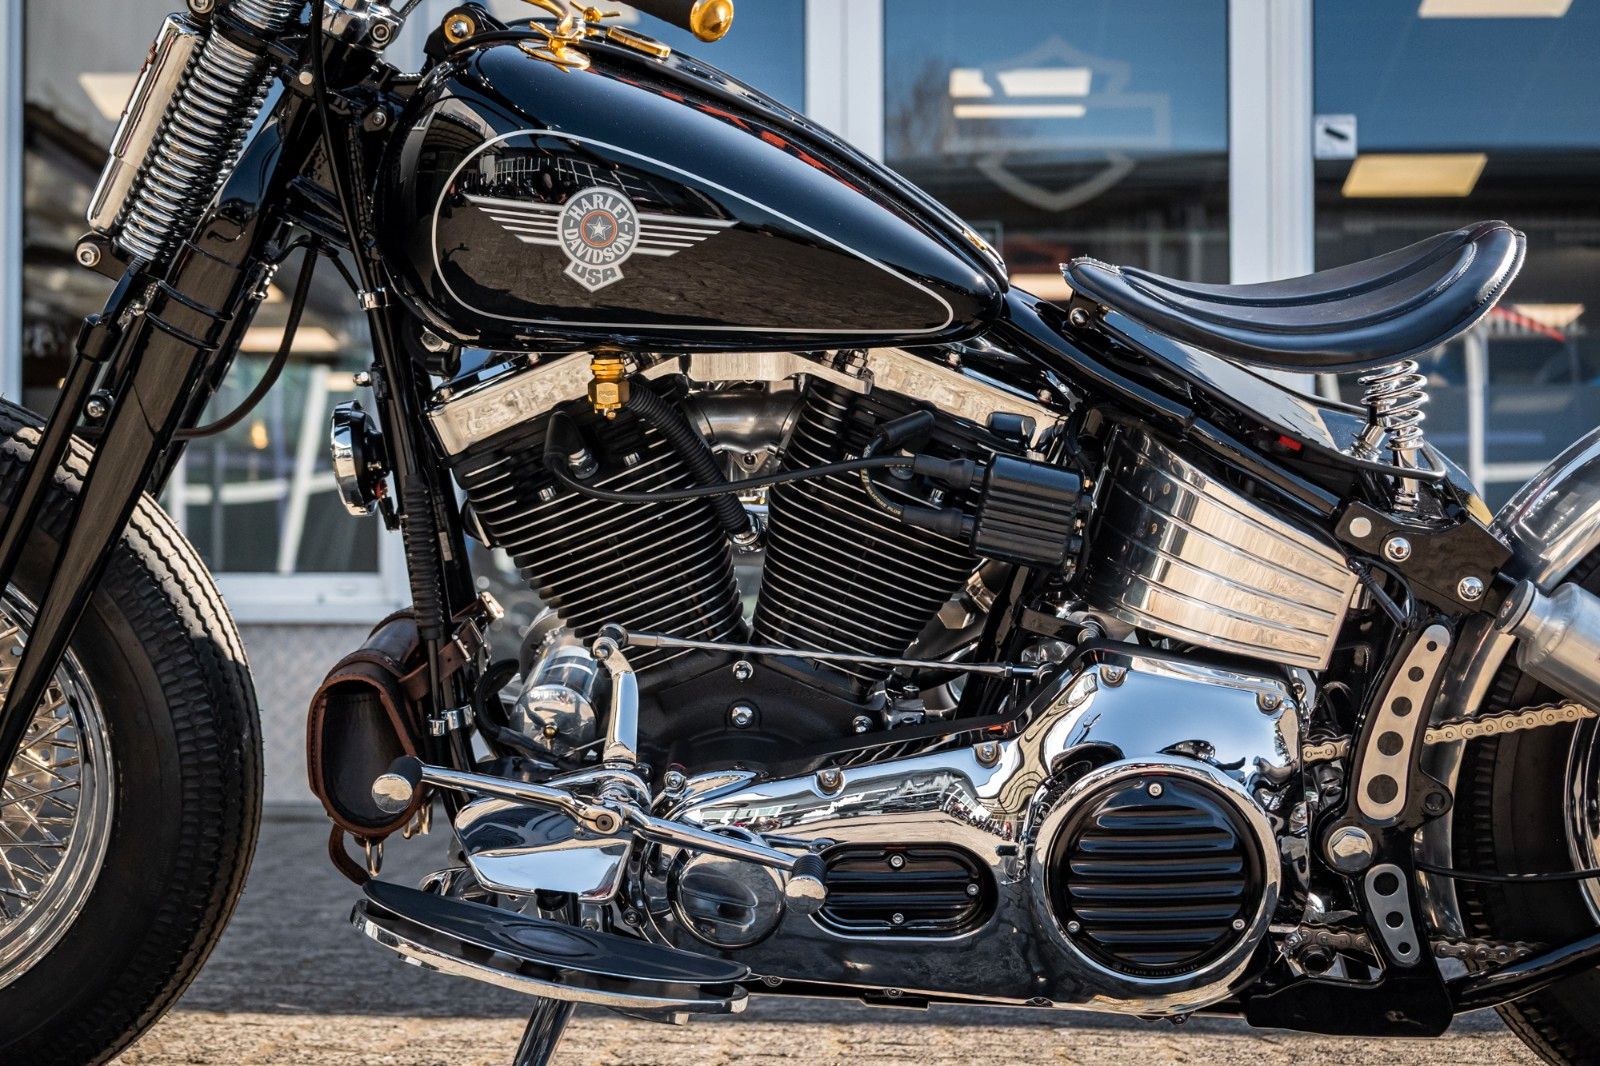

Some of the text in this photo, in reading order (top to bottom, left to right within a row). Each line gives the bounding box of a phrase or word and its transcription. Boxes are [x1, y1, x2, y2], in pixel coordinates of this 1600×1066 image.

[567, 194, 633, 225] HARLEY
[564, 228, 633, 263] DAVIDSON
[571, 262, 618, 286] USA
